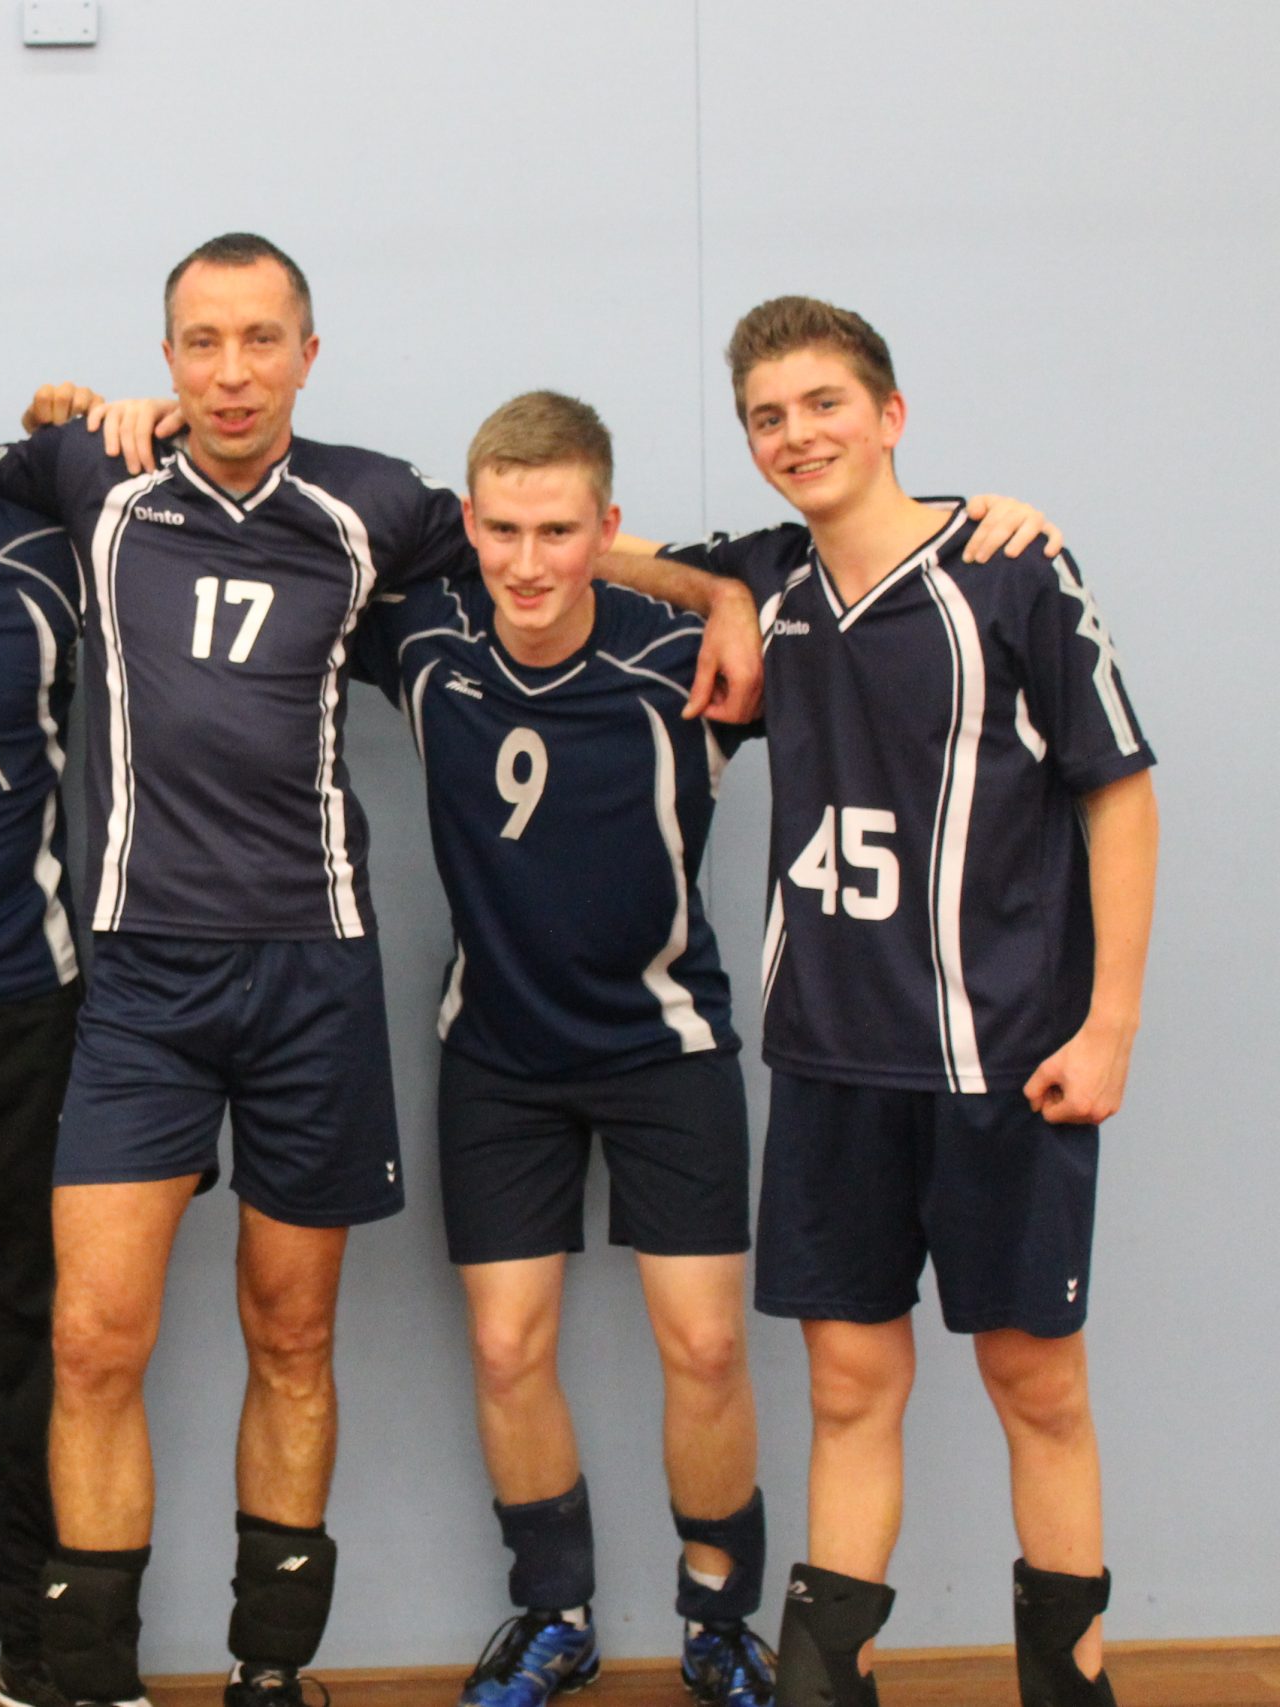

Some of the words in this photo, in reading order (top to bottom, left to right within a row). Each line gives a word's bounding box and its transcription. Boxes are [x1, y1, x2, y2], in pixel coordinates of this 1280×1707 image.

[133, 506, 185, 526] Dinto
[190, 575, 275, 664] 17
[774, 618, 810, 636] Dinto
[495, 727, 548, 840] 9
[787, 804, 900, 921] 45
